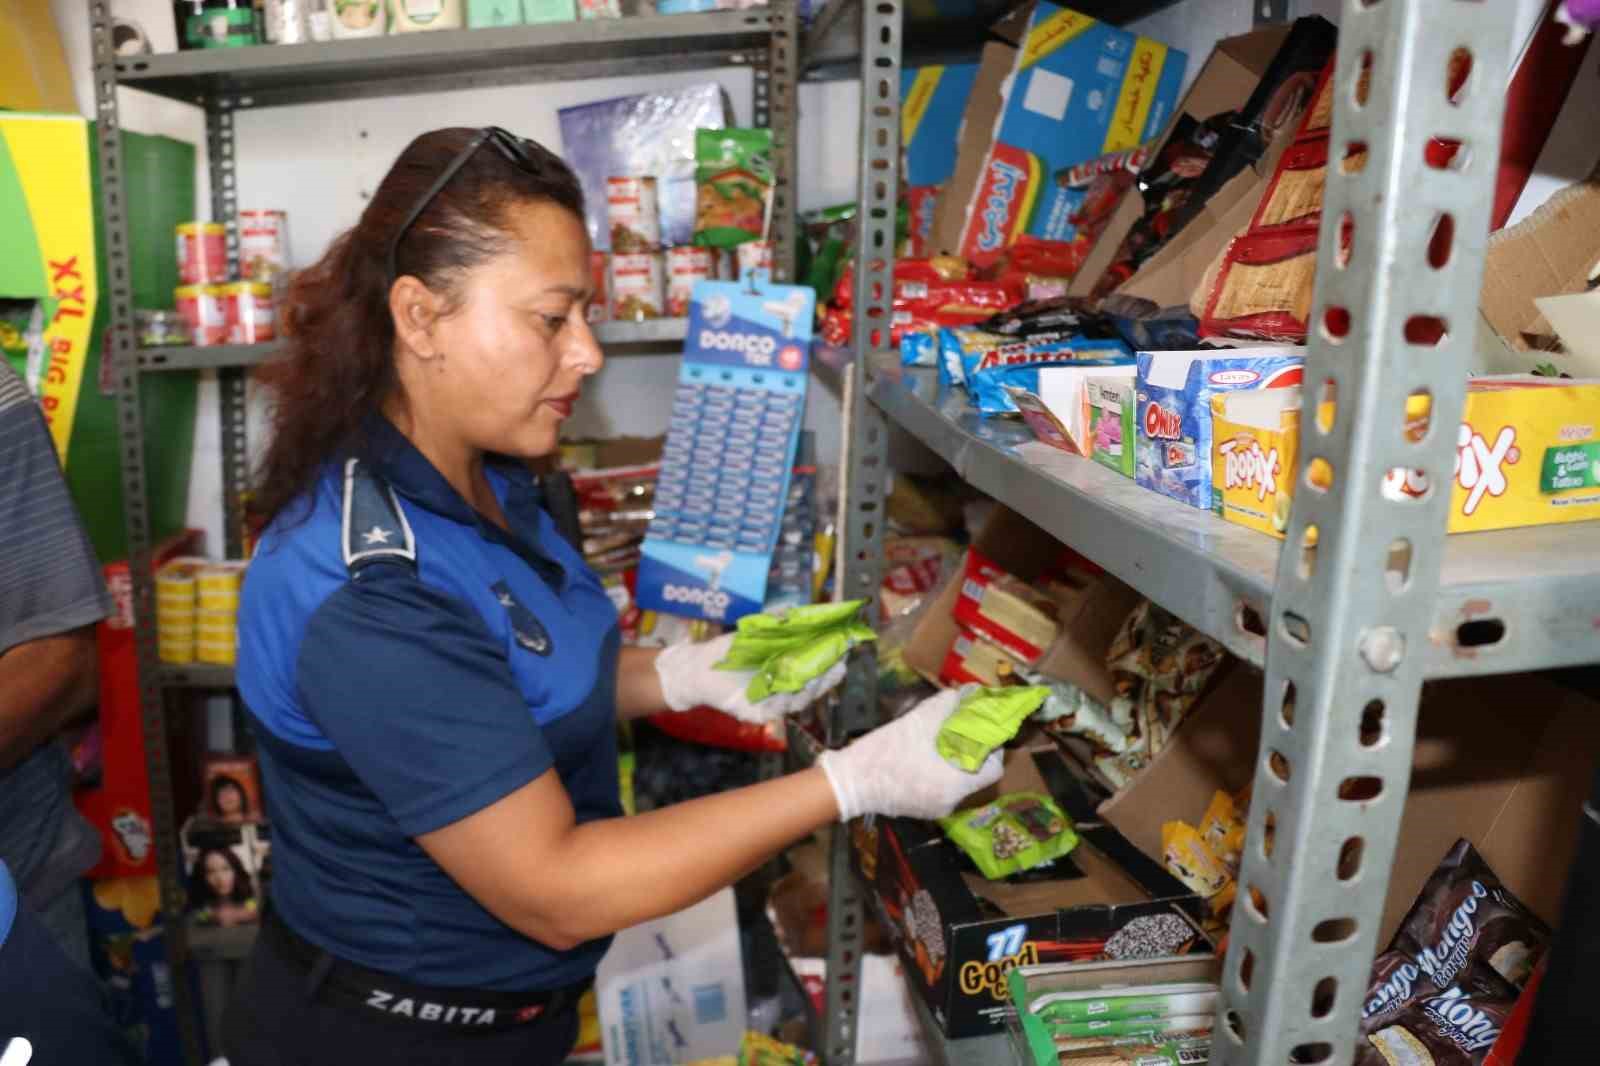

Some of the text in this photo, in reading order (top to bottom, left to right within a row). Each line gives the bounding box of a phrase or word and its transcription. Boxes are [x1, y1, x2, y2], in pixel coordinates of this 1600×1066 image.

[49, 256, 85, 323] XXL
[48, 340, 71, 384] BIG
[986, 923, 1028, 962] 77
[960, 940, 1039, 995] Good
[367, 989, 496, 1024] ZABITA
